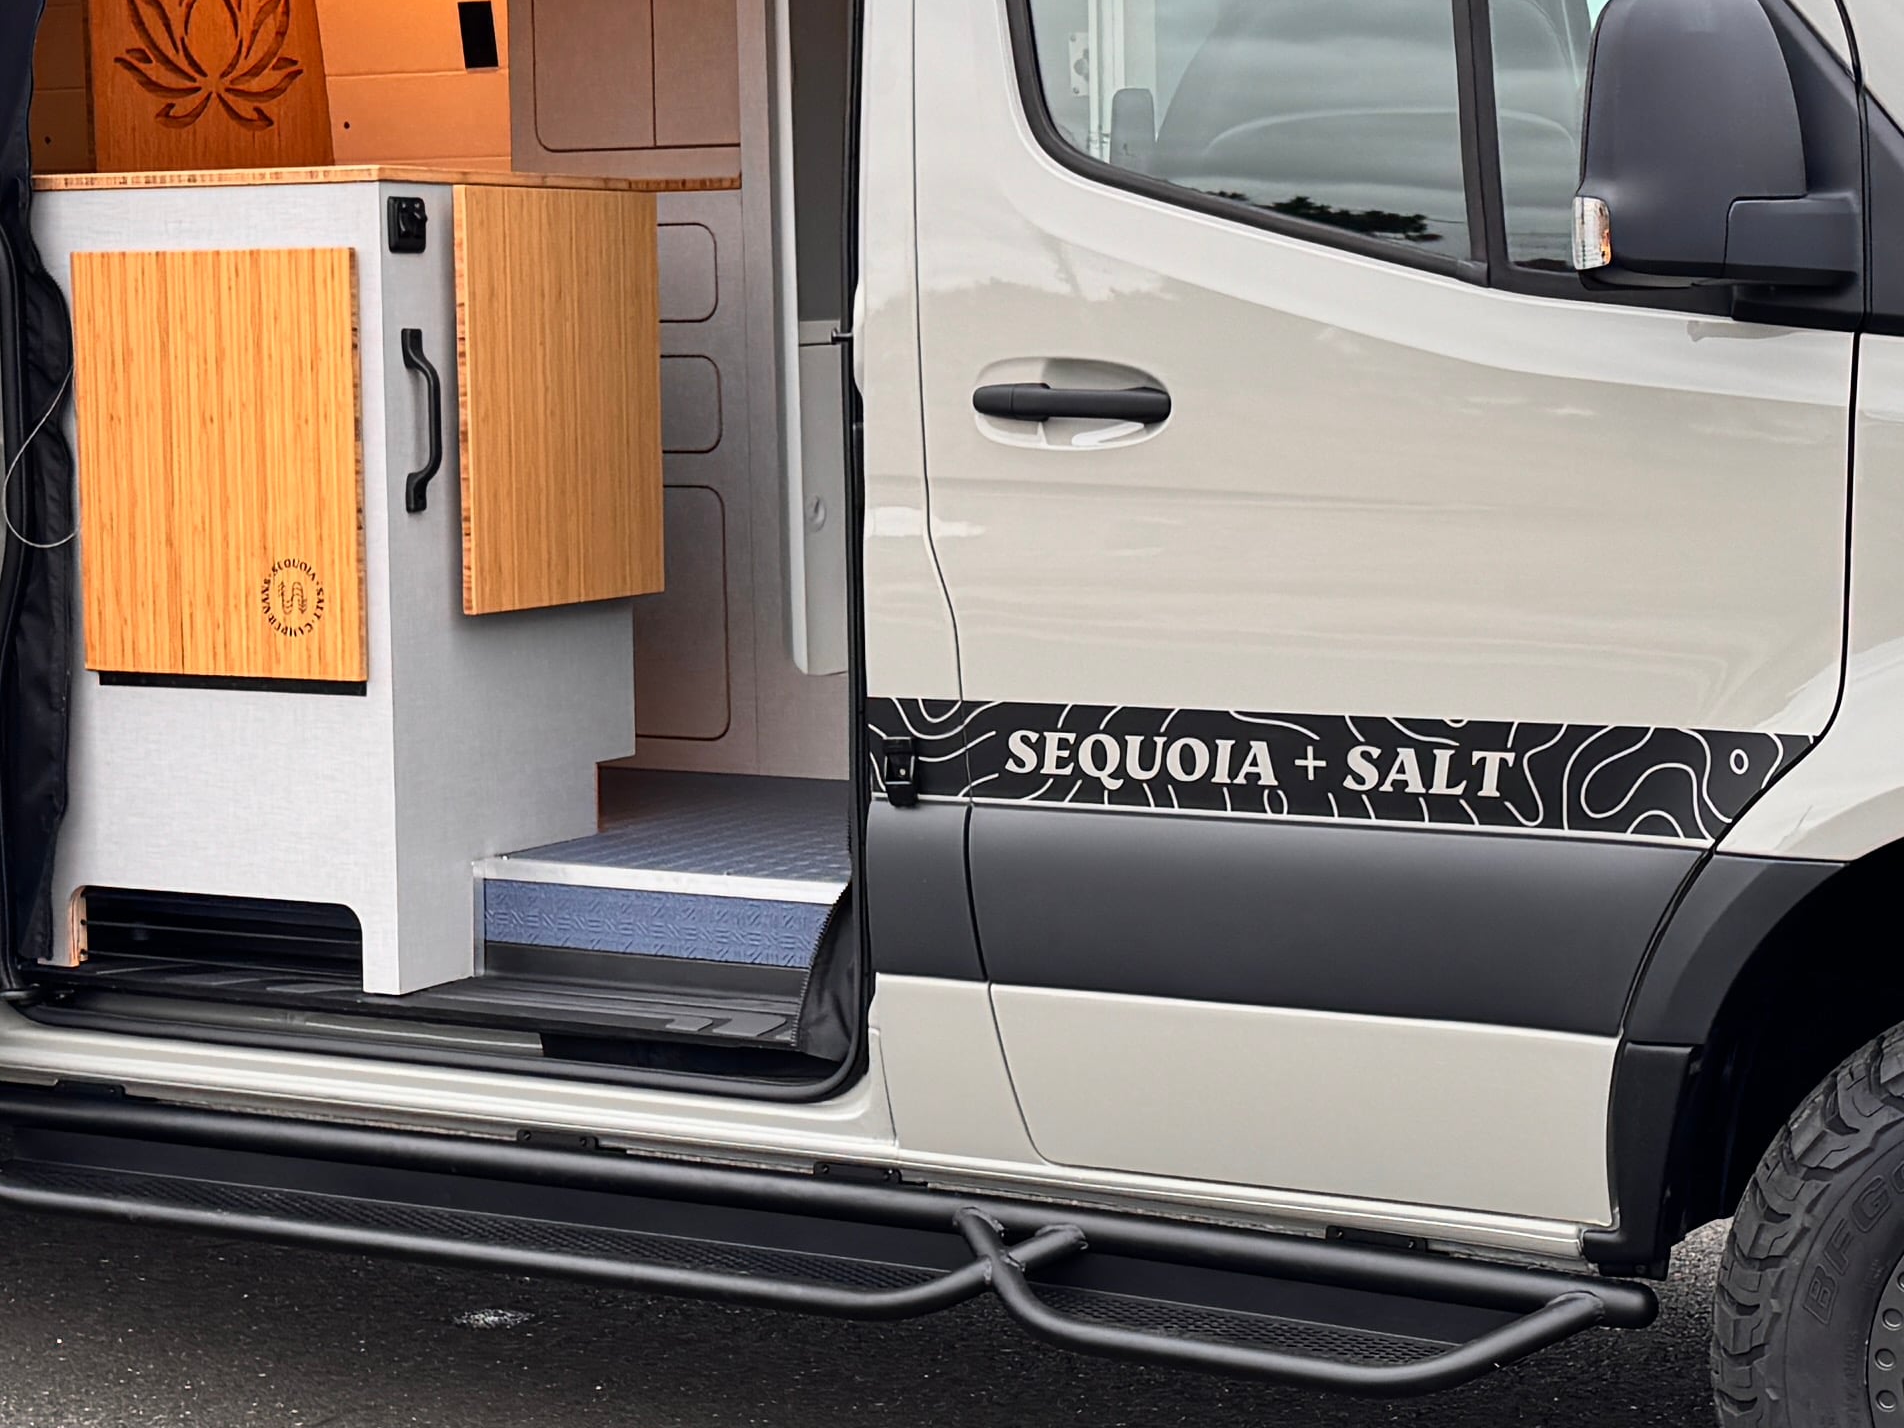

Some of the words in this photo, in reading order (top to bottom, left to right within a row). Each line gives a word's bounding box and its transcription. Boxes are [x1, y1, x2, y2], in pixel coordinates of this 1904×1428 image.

[1005, 729, 1279, 791] SEQUOIA
[1295, 746, 1326, 780] +
[1341, 745, 1517, 797] SALT
